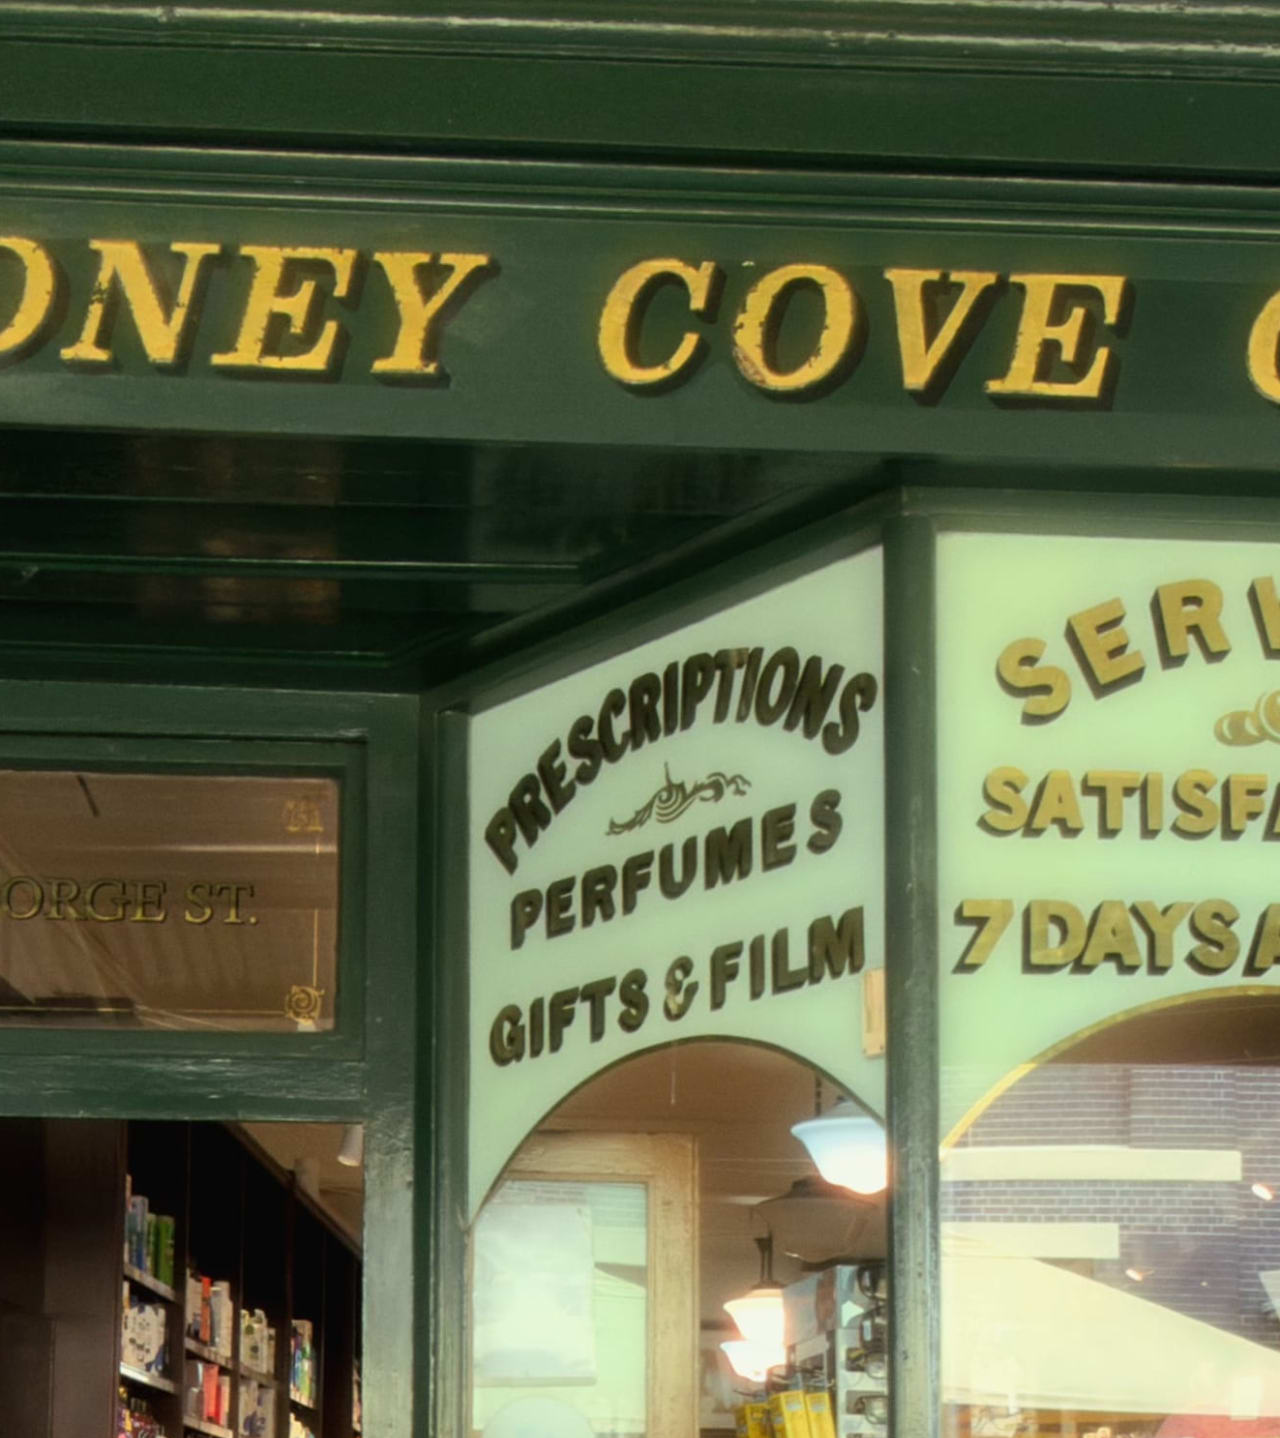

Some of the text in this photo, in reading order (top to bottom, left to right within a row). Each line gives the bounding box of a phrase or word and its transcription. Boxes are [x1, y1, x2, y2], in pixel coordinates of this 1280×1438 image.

[597, 256, 1131, 405] COVE
[484, 646, 878, 875] PRESCRIPTIONS
[183, 881, 260, 926] ST.
[510, 788, 844, 950] PERFUMES
[1021, 899, 1241, 977] DAYS
[489, 906, 866, 1068] GIFTS & FILM
